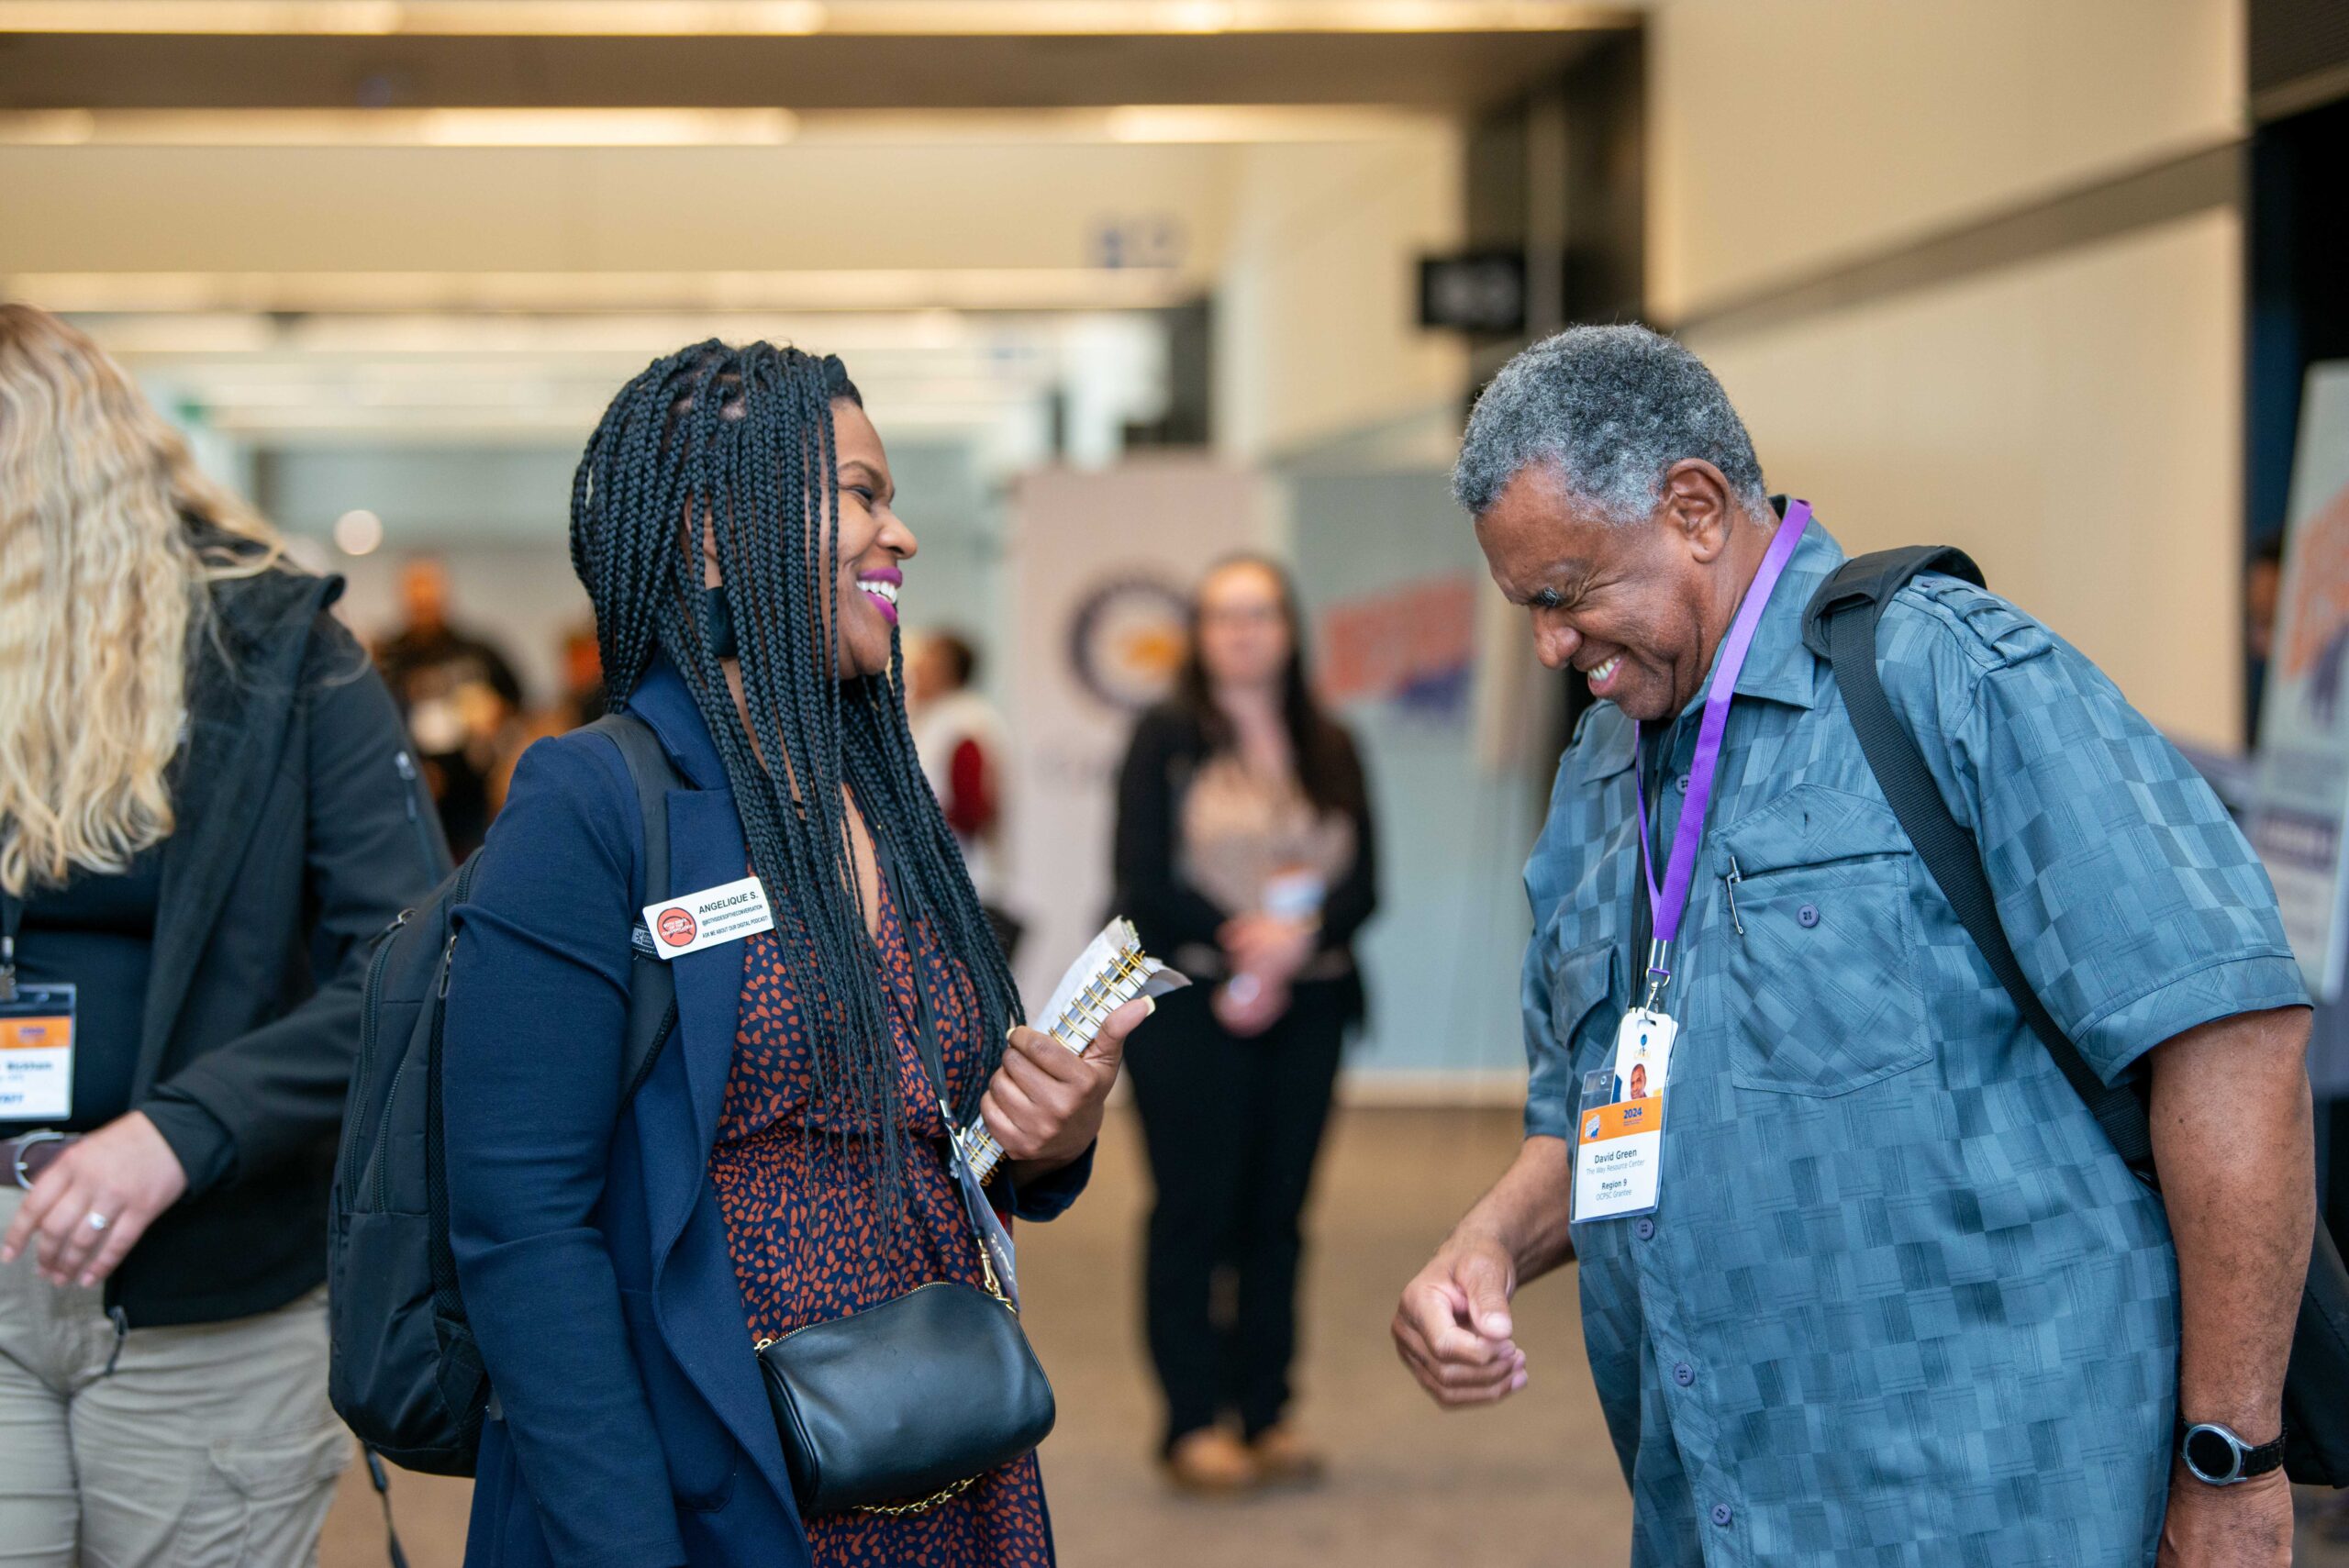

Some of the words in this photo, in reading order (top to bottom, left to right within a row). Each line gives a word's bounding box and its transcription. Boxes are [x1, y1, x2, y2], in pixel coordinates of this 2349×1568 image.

[699, 893, 749, 914] ANGELIQUE
[750, 891, 759, 900] S.
[702, 930, 710, 939] ASK
[717, 926, 729, 934] ABOUT
[729, 923, 738, 931] OUR
[738, 920, 751, 929] DIGITAL
[1623, 1106, 1642, 1119] 2024
[1595, 1151, 1614, 1163] David
[1616, 1149, 1637, 1160] Green
[1607, 1162, 1628, 1172] Resource
[1629, 1159, 1645, 1168] Center
[1602, 1181, 1621, 1191] Region
[1623, 1178, 1628, 1186] 9
[1613, 1189, 1632, 1198] Grantee
